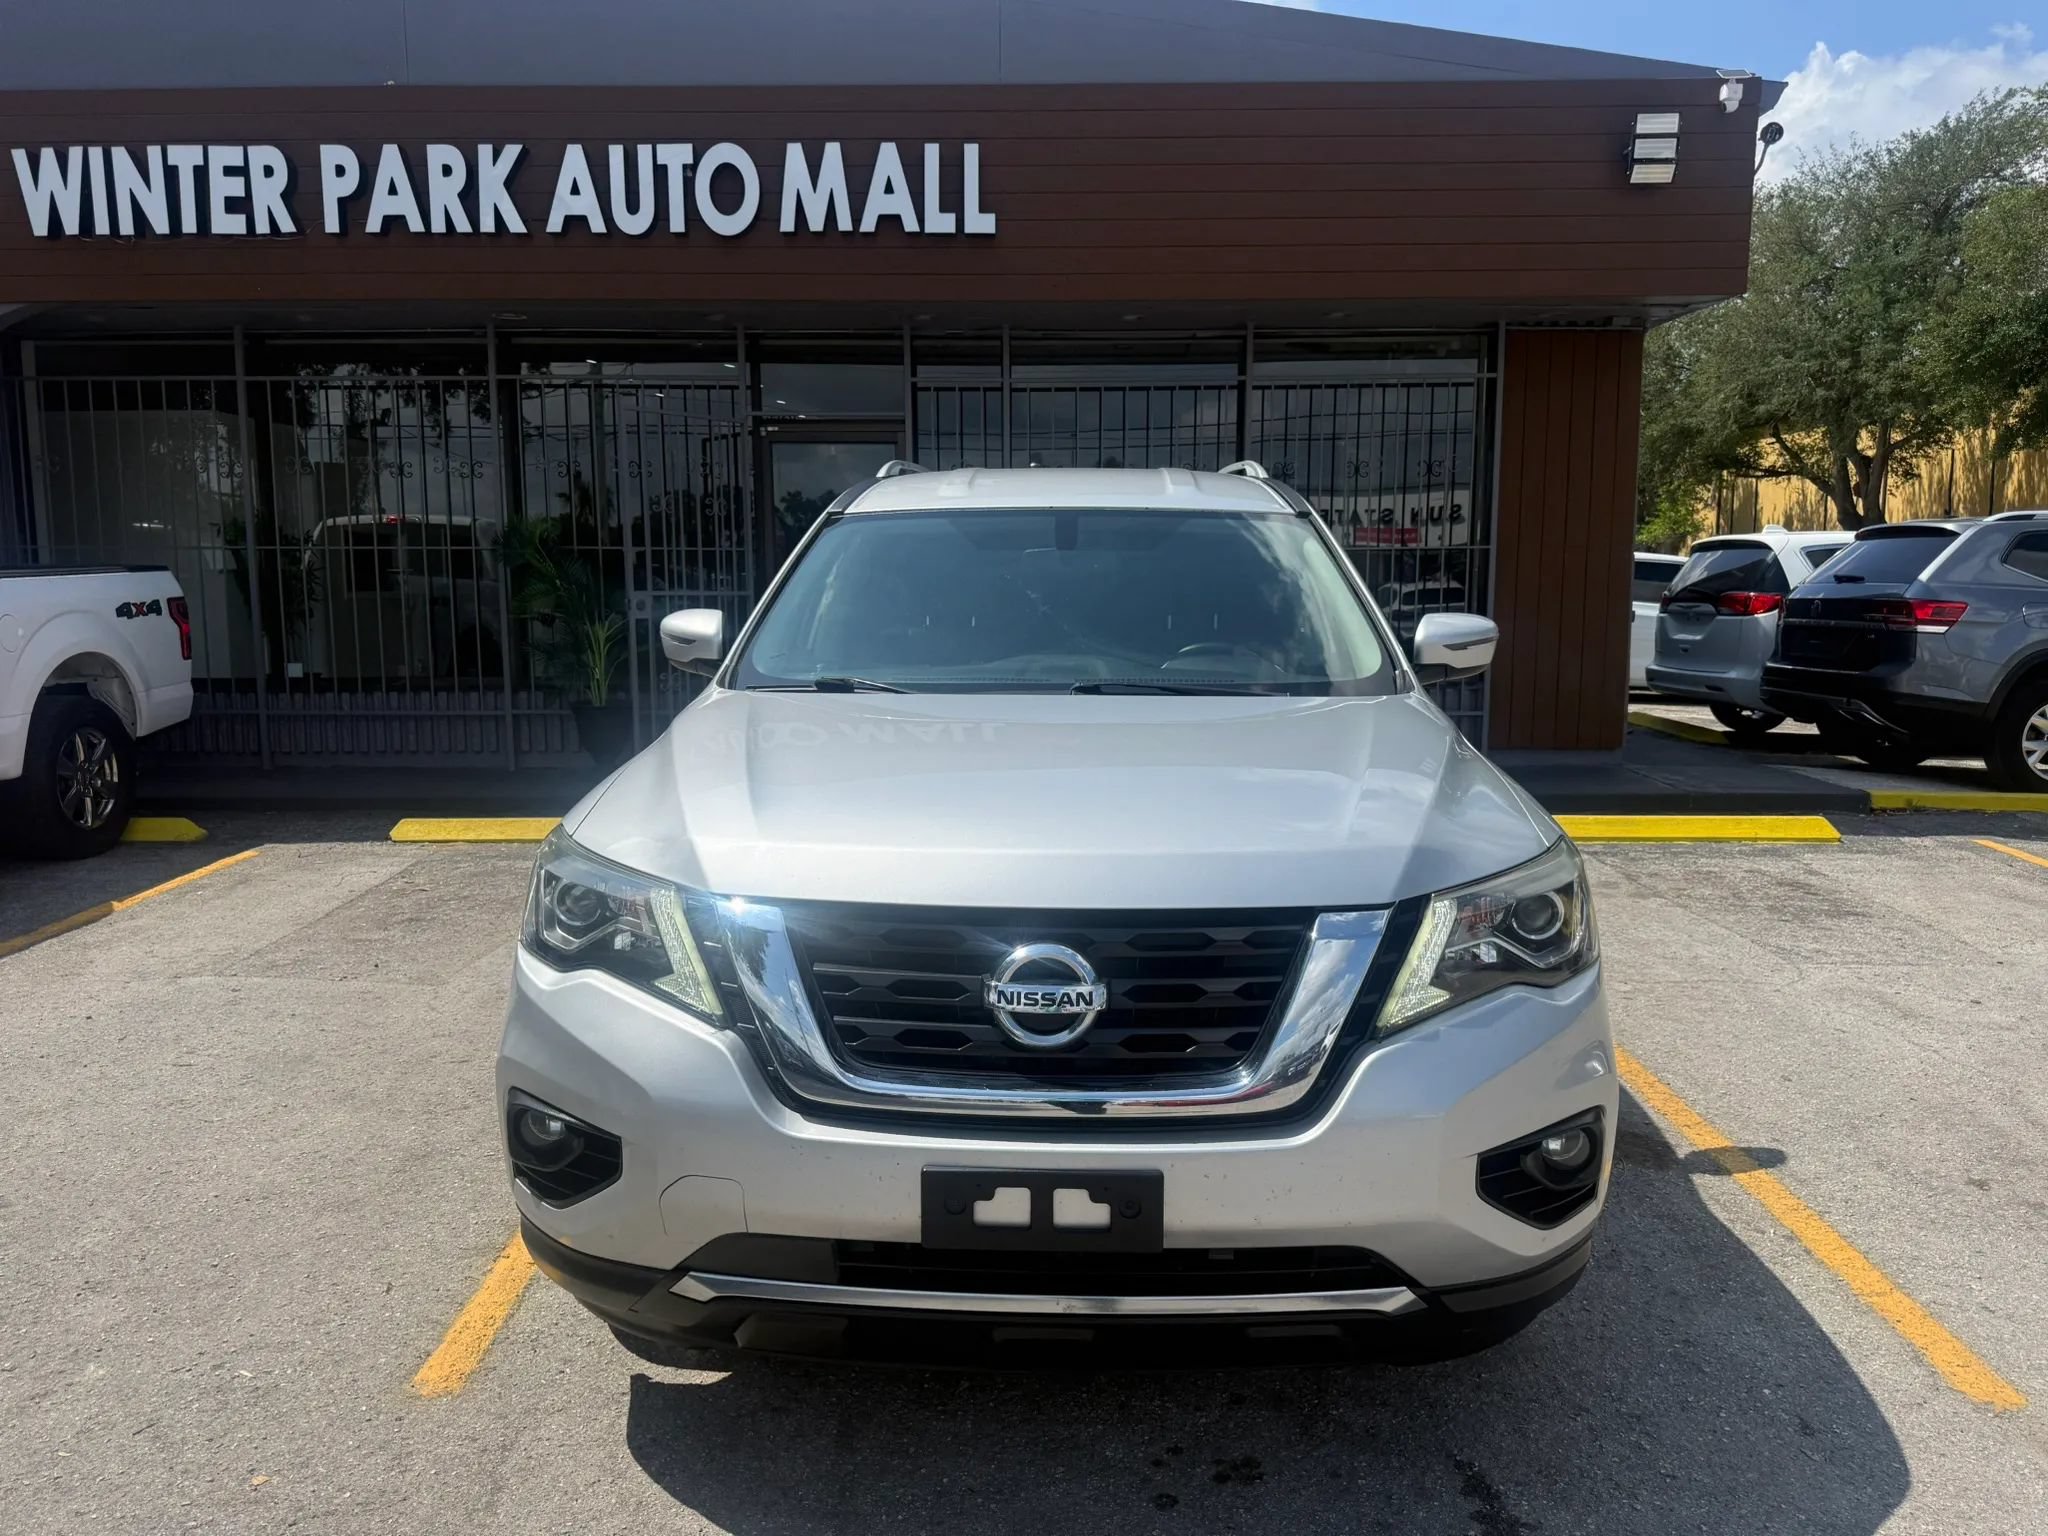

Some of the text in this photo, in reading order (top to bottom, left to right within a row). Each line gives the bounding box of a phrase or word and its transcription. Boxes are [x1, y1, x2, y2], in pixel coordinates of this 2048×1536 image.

[10, 141, 996, 237] WINTER PARK AUTO MALL
[996, 989, 1094, 1008] NISSAN
